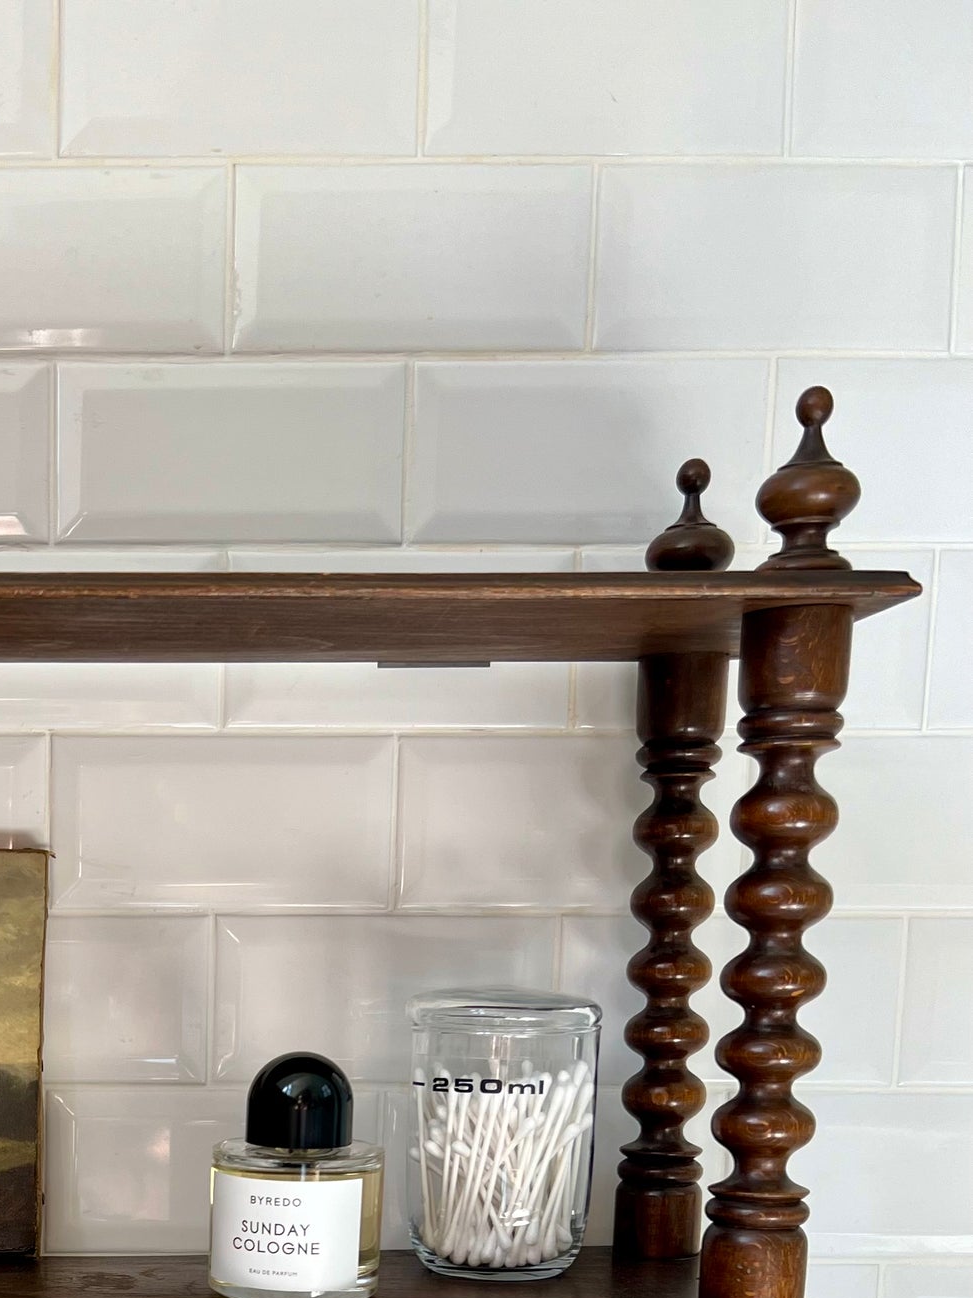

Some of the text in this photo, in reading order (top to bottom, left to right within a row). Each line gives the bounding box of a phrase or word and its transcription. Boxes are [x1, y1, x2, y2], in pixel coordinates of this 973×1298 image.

[250, 1195, 302, 1207] BYREDO
[241, 1220, 310, 1236] SUNDAY
[232, 1237, 320, 1255] COLOGNE
